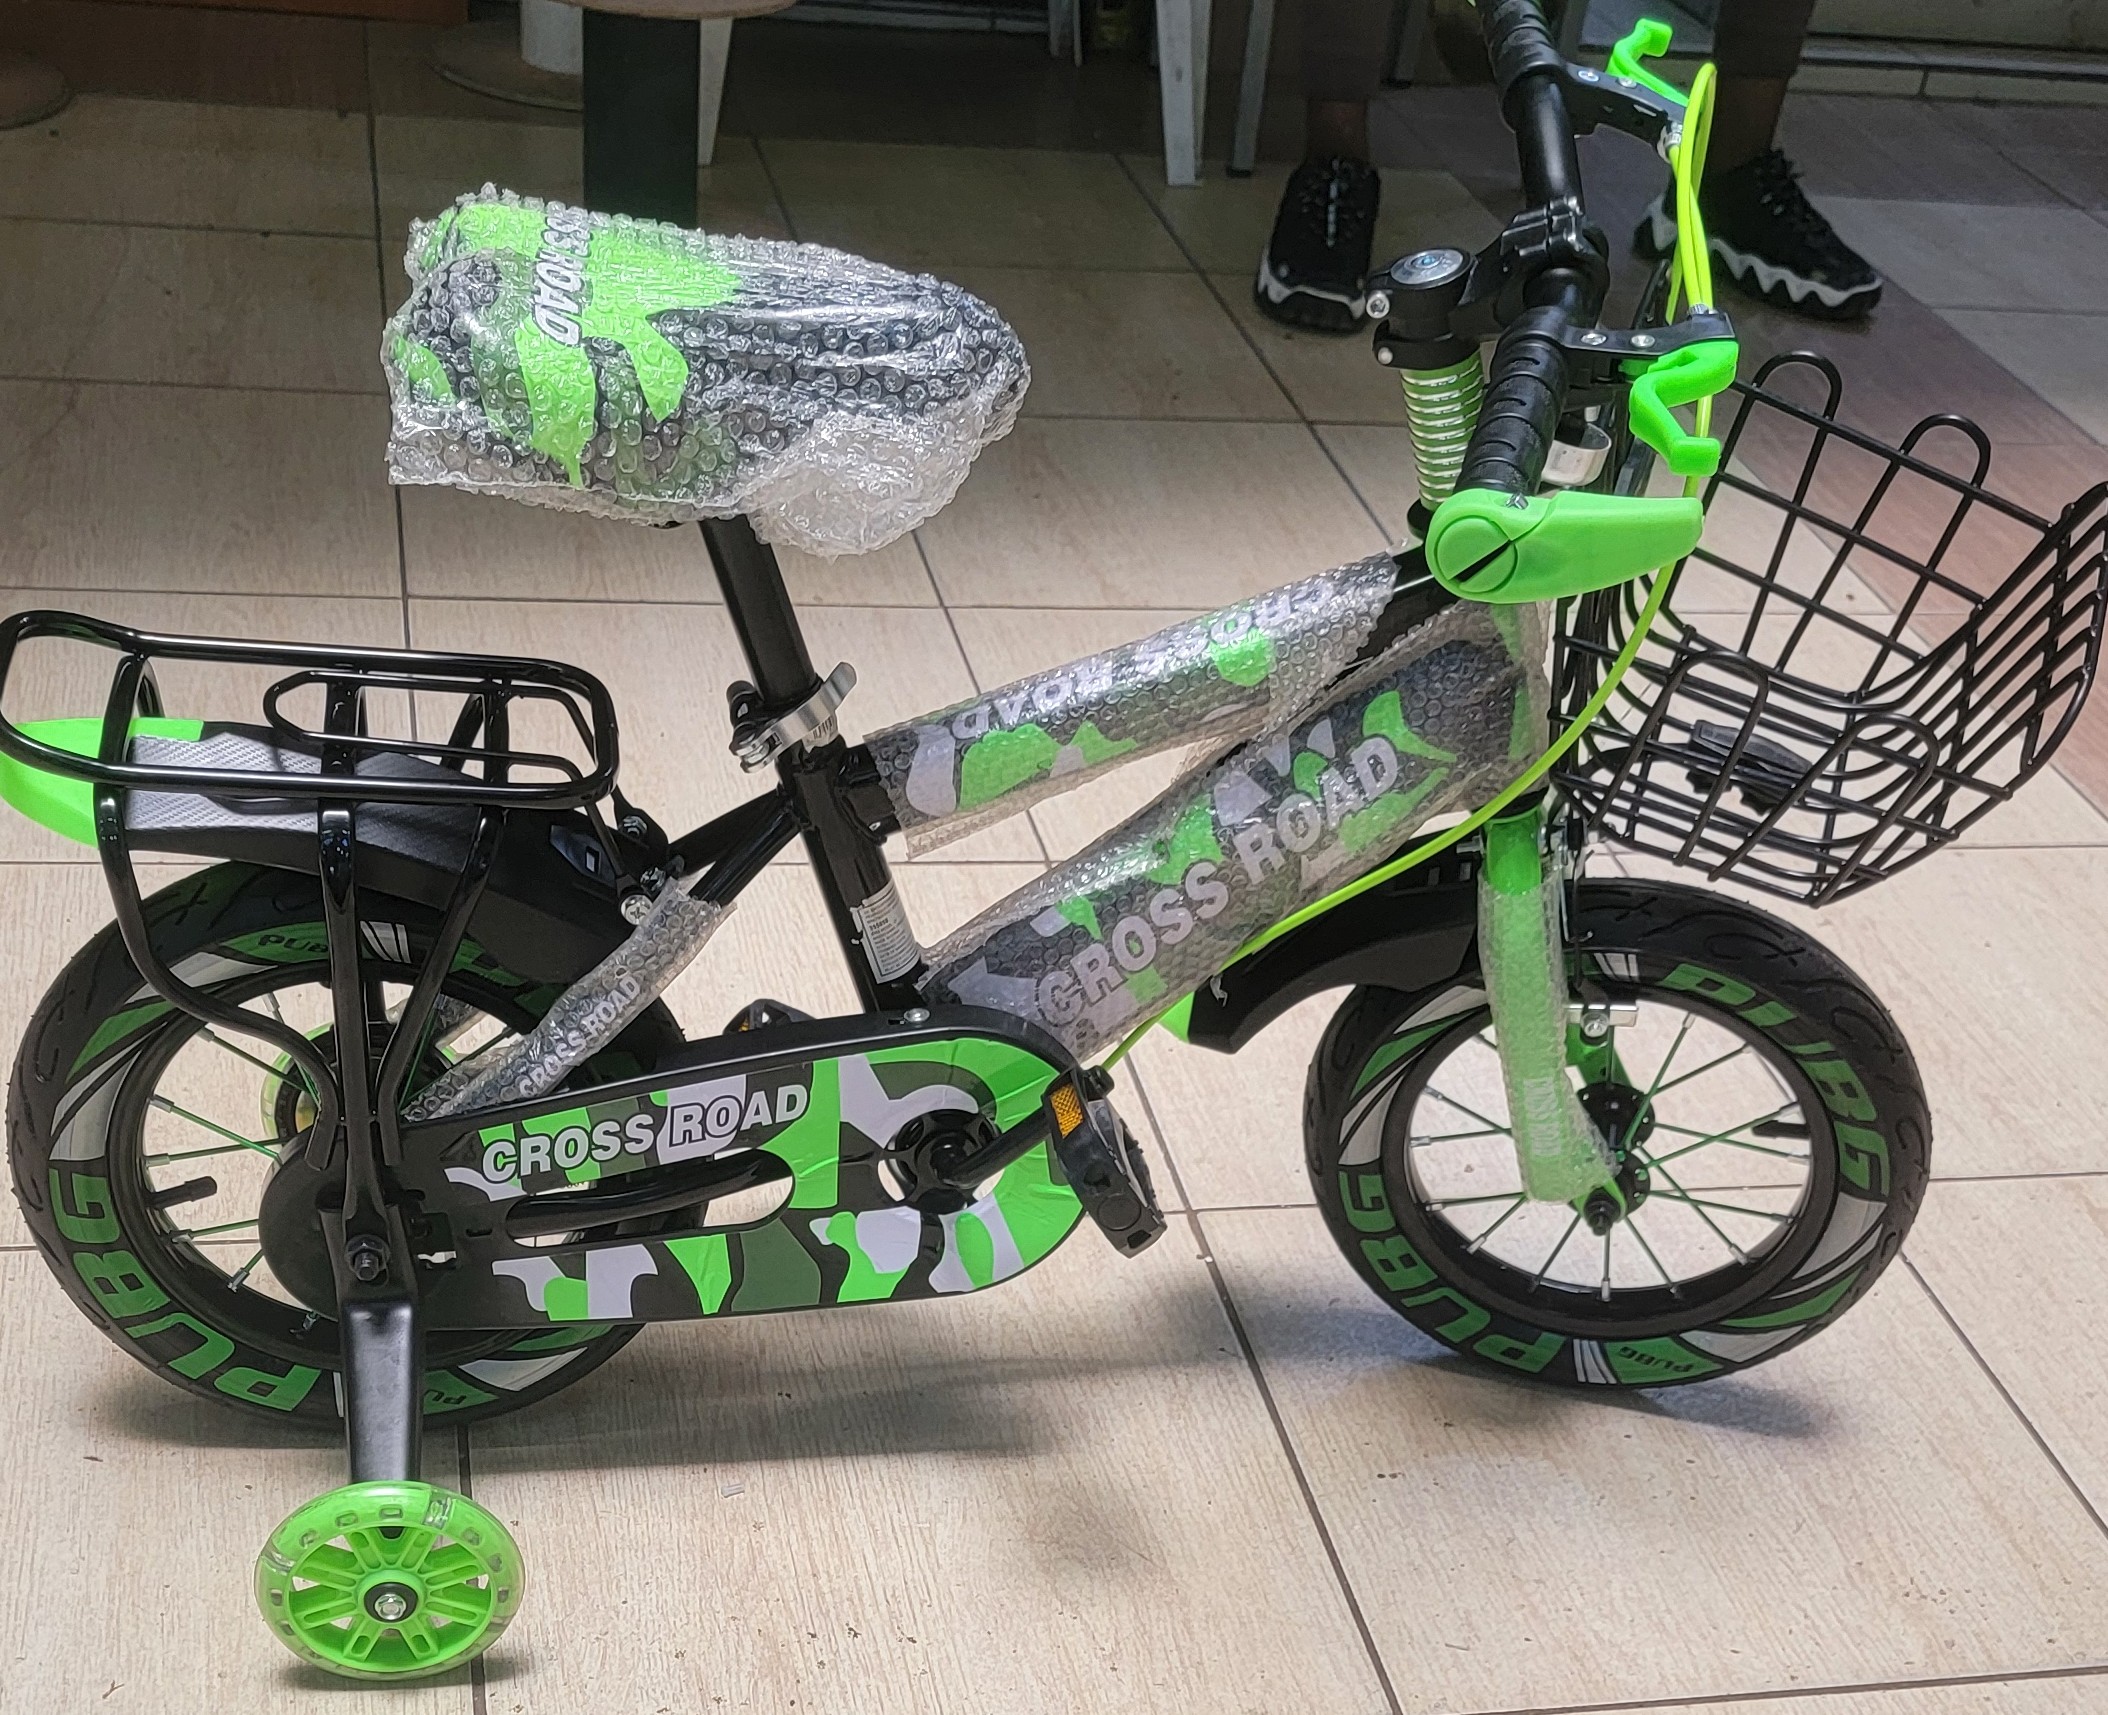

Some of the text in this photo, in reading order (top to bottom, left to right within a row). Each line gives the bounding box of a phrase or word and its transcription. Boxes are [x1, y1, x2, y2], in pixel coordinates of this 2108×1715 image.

[258, 934, 330, 953] PUB
[1037, 861, 1229, 1027] CROSS
[1232, 736, 1398, 885] ROAD
[519, 976, 640, 1098] CROSS ROAD
[1658, 962, 1890, 1198] PUBG
[481, 1083, 808, 1184] CROSS ROAD
[48, 1172, 323, 1412] PUBG
[1337, 1170, 1568, 1375] PUBG
[1619, 1346, 1695, 1373] PUBG
